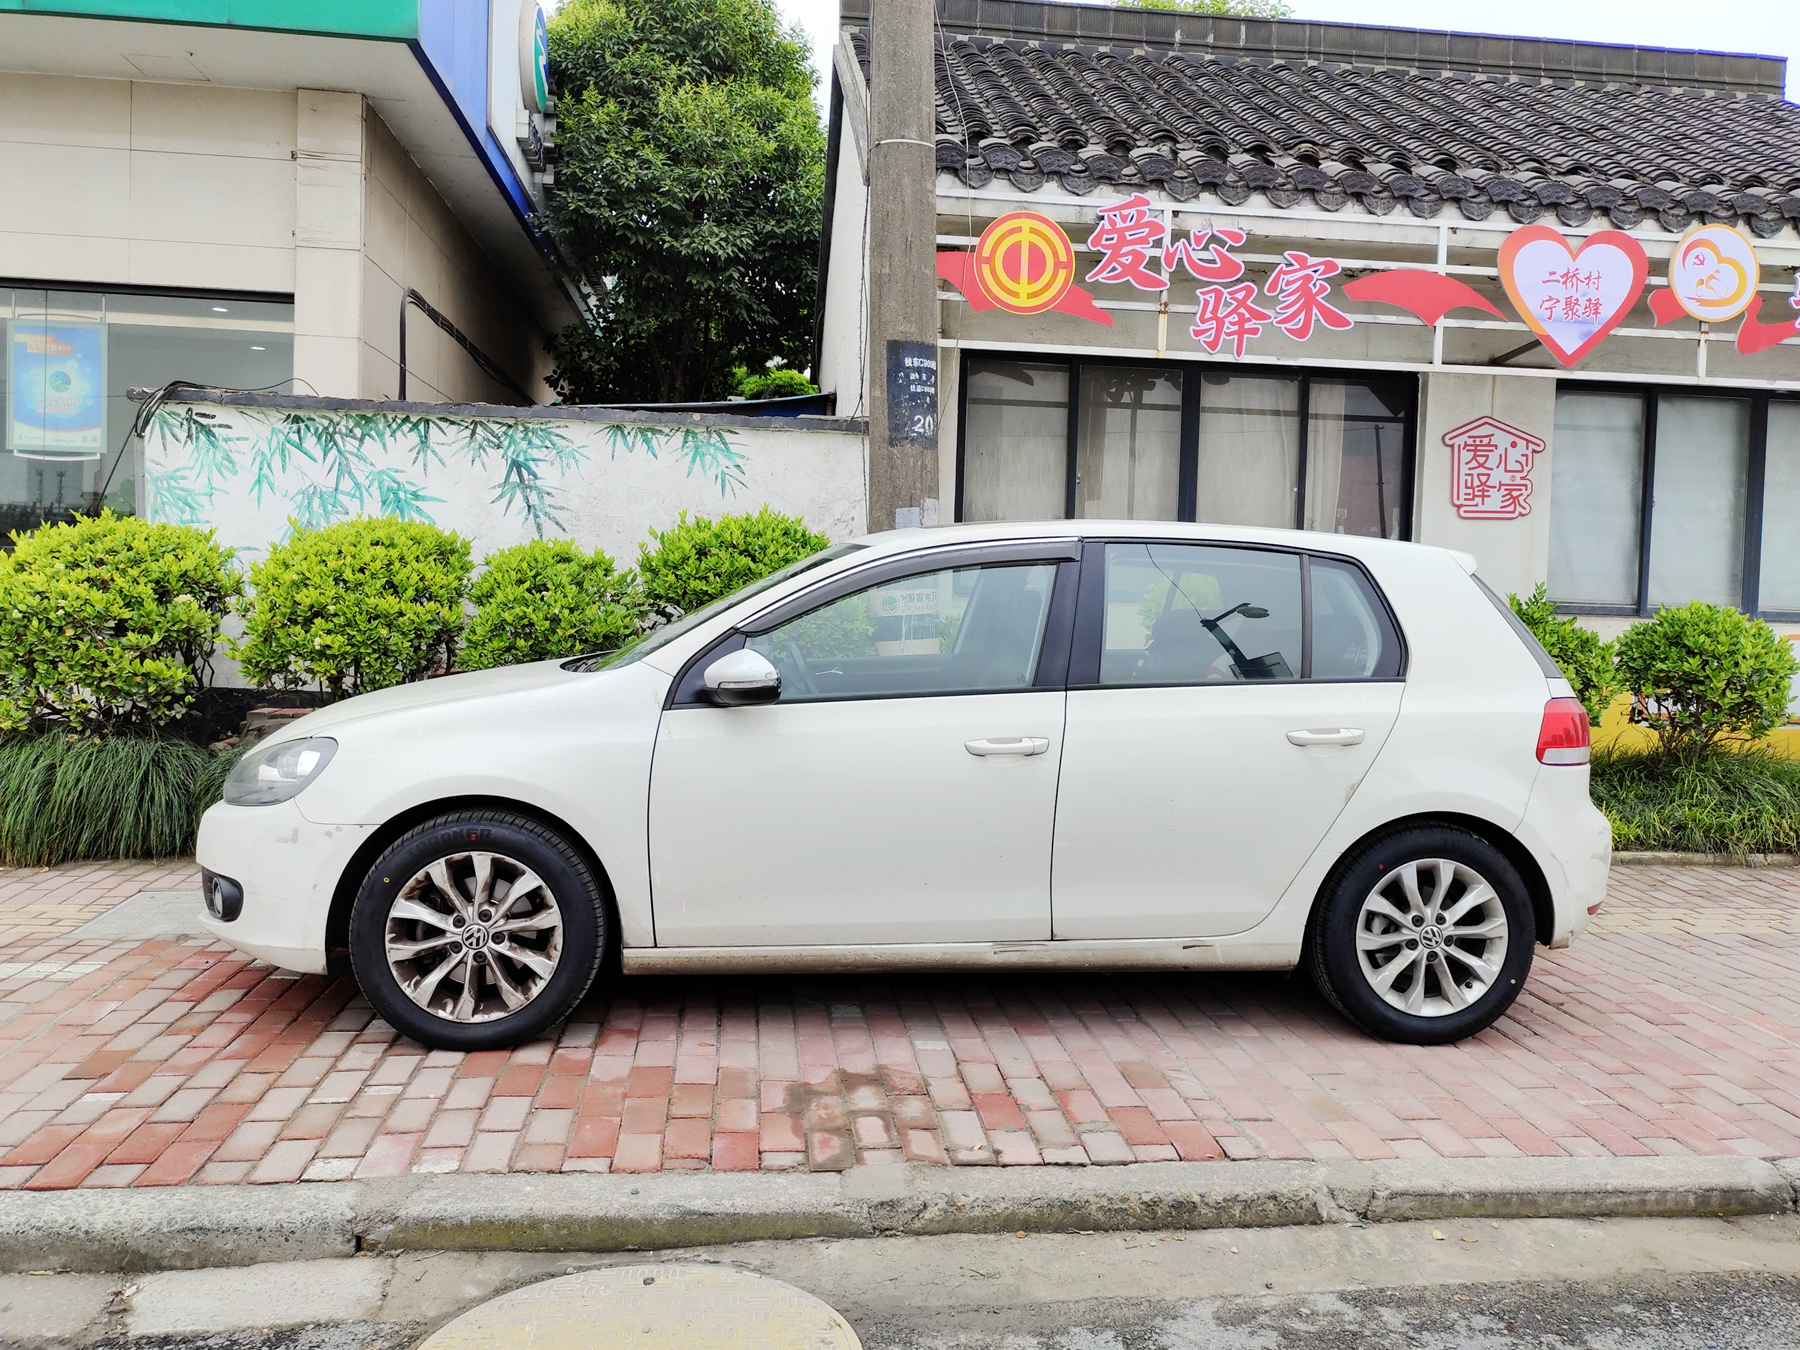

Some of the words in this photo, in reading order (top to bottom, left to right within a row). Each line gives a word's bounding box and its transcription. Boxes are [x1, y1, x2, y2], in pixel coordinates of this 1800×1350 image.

[1085, 192, 1247, 291] 爱心
[1541, 266, 1602, 293] 二桥村
[1190, 251, 1354, 361] 驿家
[1539, 296, 1602, 325] 宁聚驿
[1462, 433, 1529, 473] 爱心
[1463, 473, 1529, 513] 驿家
